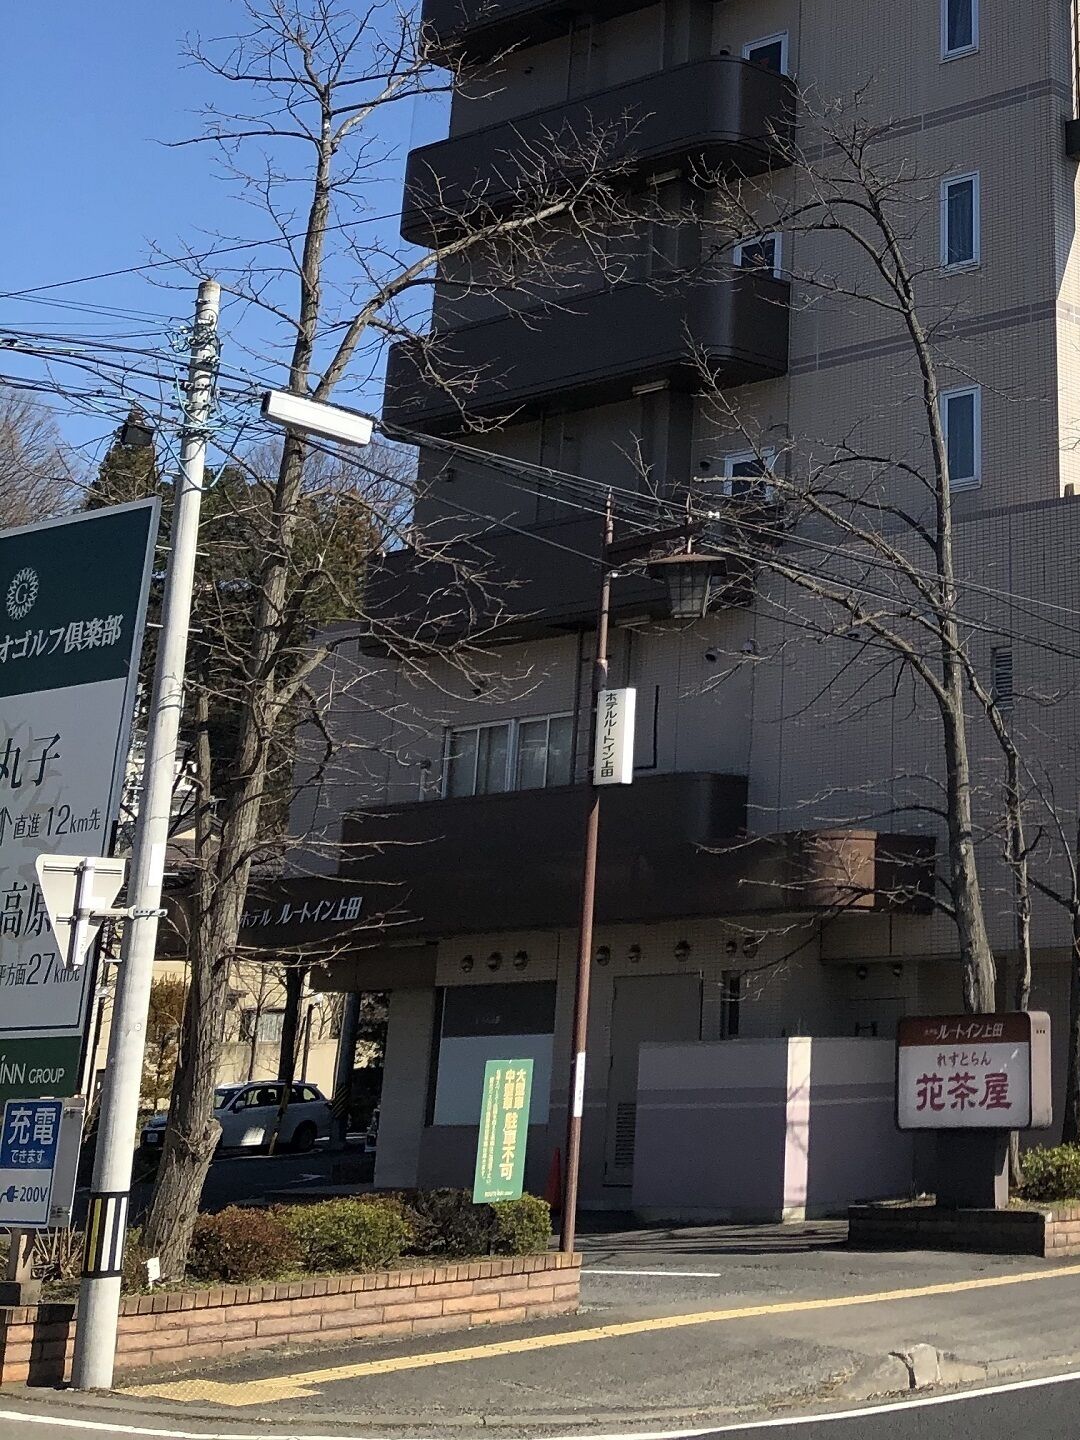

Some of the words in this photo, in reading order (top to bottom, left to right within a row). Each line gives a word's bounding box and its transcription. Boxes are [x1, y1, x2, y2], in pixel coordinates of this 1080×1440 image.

[601, 692, 618, 778] ホテルルートイン上田
[0, 733, 61, 789] 丸子
[240, 908, 272, 928] ホテル
[275, 896, 363, 926] ルートイン上田
[936, 1022, 1004, 1040] ルートイン上田
[937, 1051, 992, 1068] れすとらん
[28, 1068, 65, 1084] GROUP
[915, 1071, 1013, 1112] 花茶屋
[7, 1106, 57, 1146] 充電
[10, 1148, 46, 1164] できます
[19, 1186, 49, 1203] 200V
